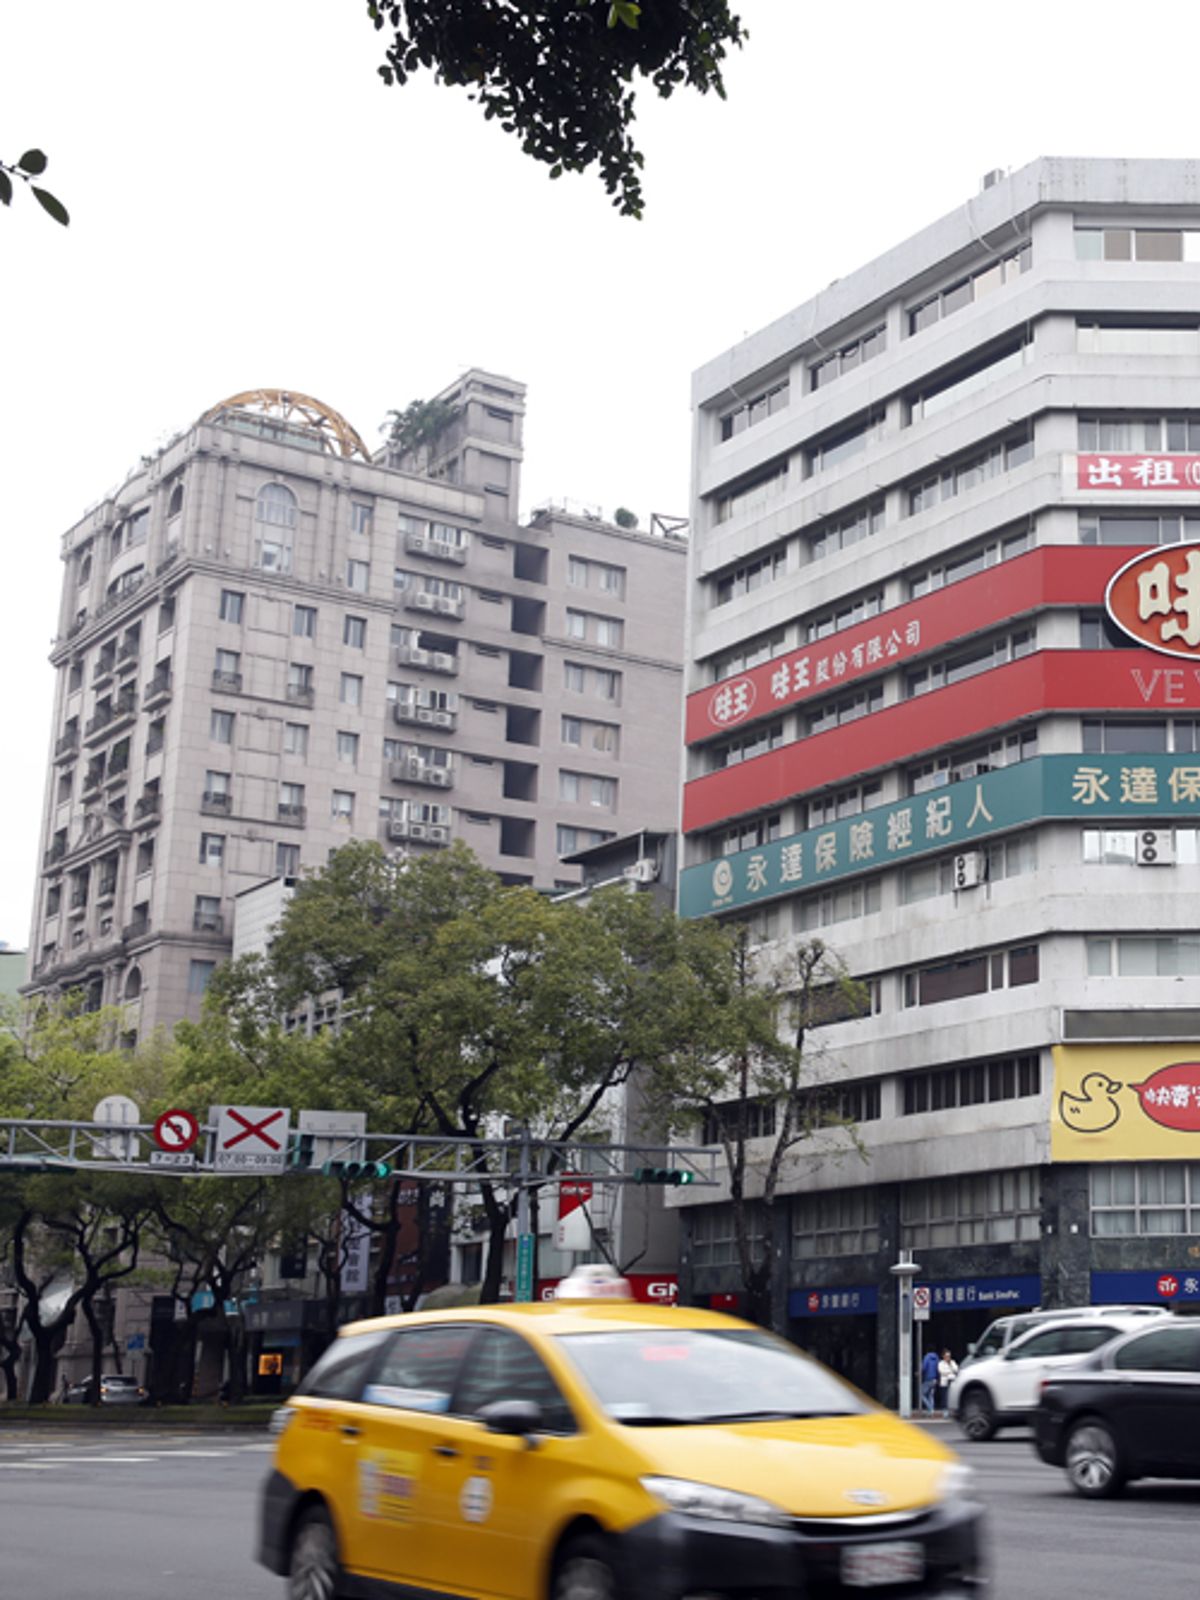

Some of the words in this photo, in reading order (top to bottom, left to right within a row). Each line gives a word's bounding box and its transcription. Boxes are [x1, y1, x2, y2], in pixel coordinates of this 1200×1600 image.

[1087, 458, 1179, 487] 出租
[771, 620, 921, 700] 味王股份有限公司
[1130, 668, 1186, 703] VE
[746, 784, 994, 892] 永達保險經紀人
